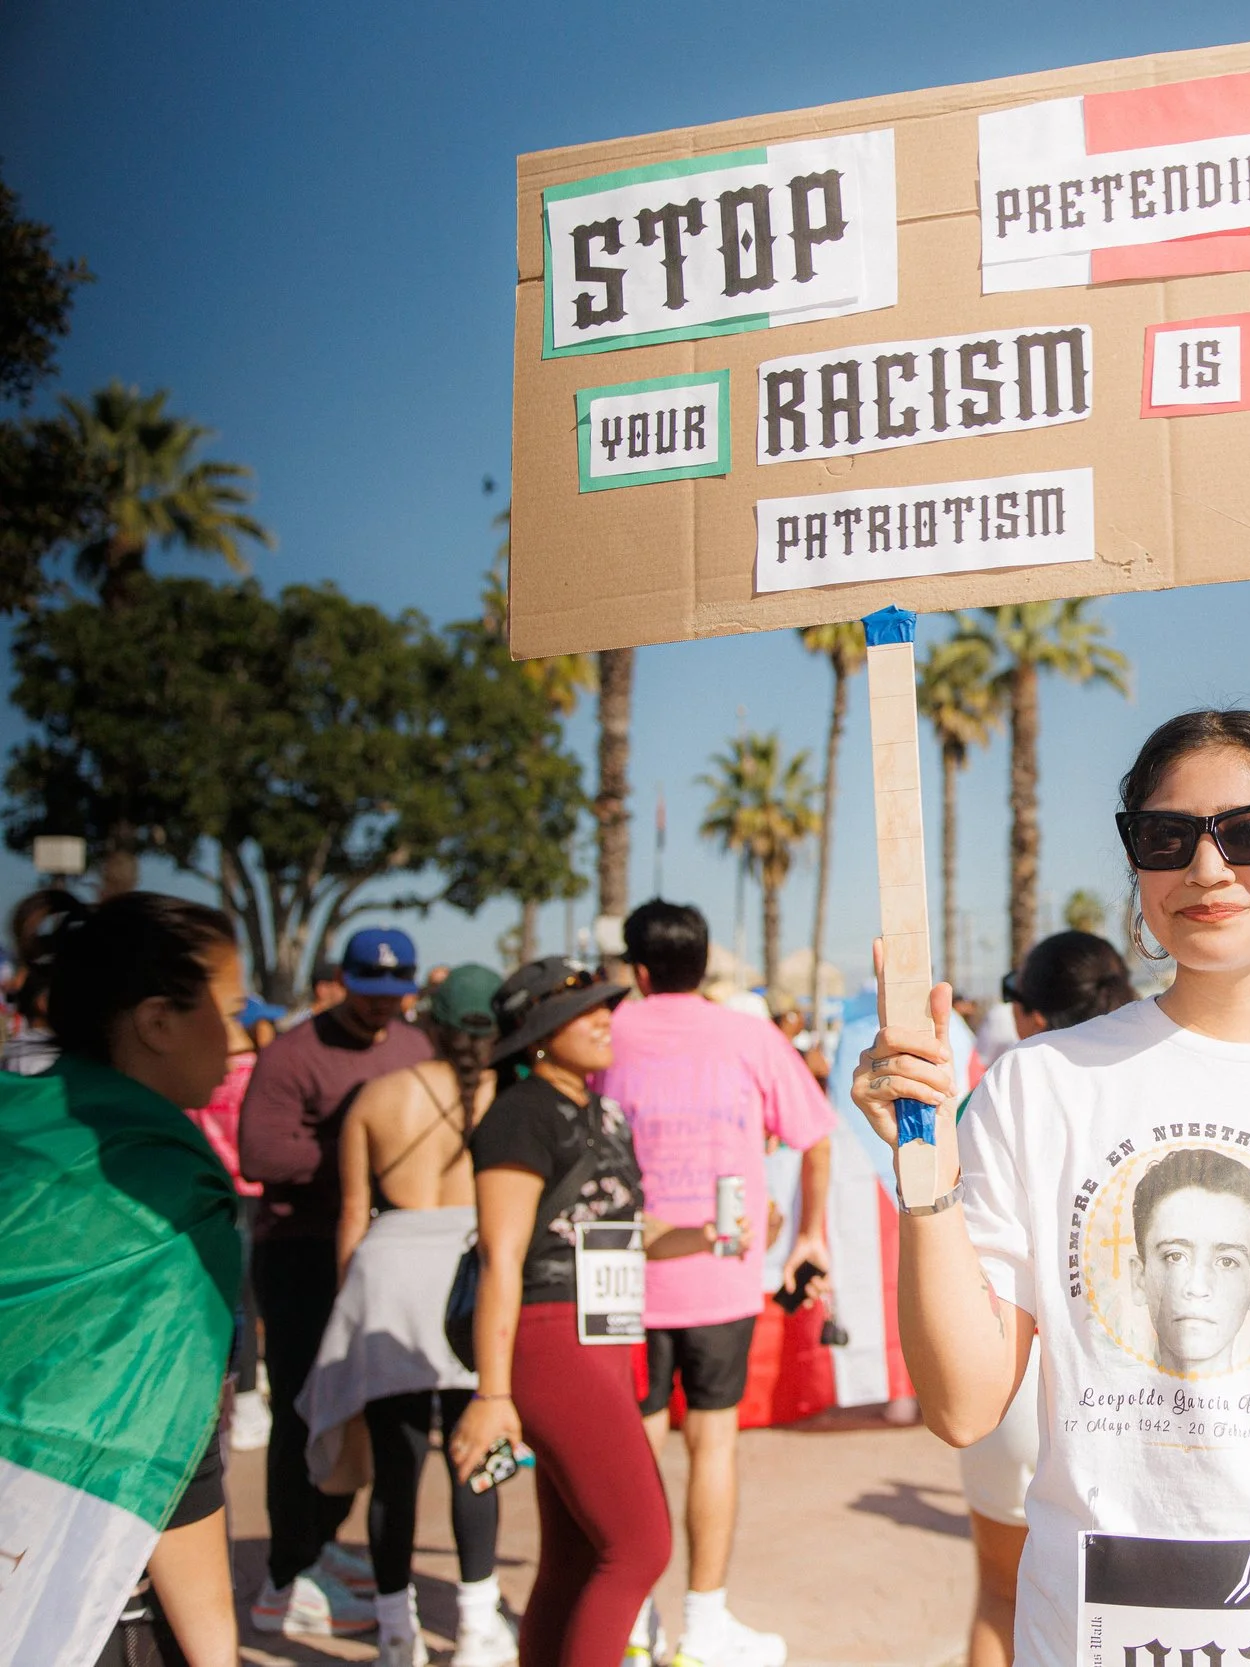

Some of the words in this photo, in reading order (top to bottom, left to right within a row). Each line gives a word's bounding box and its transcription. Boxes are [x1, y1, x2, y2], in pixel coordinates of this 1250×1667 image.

[571, 168, 849, 330] STOP
[600, 402, 707, 459] YOUR
[763, 327, 1091, 457] RACISM
[1179, 340, 1222, 390] IS
[776, 487, 1067, 563] PATRIOTISM
[1069, 1178, 1099, 1298] SIEMPRE
[1105, 1138, 1136, 1168] EN
[1063, 1419, 1078, 1432] 17
[1087, 1417, 1132, 1437] Mayo
[1138, 1418, 1171, 1433] 1942
[1188, 1421, 1206, 1435] 20
[1079, 1387, 1165, 1412] Leopoldo
[1090, 1616, 1103, 1649] Walk
